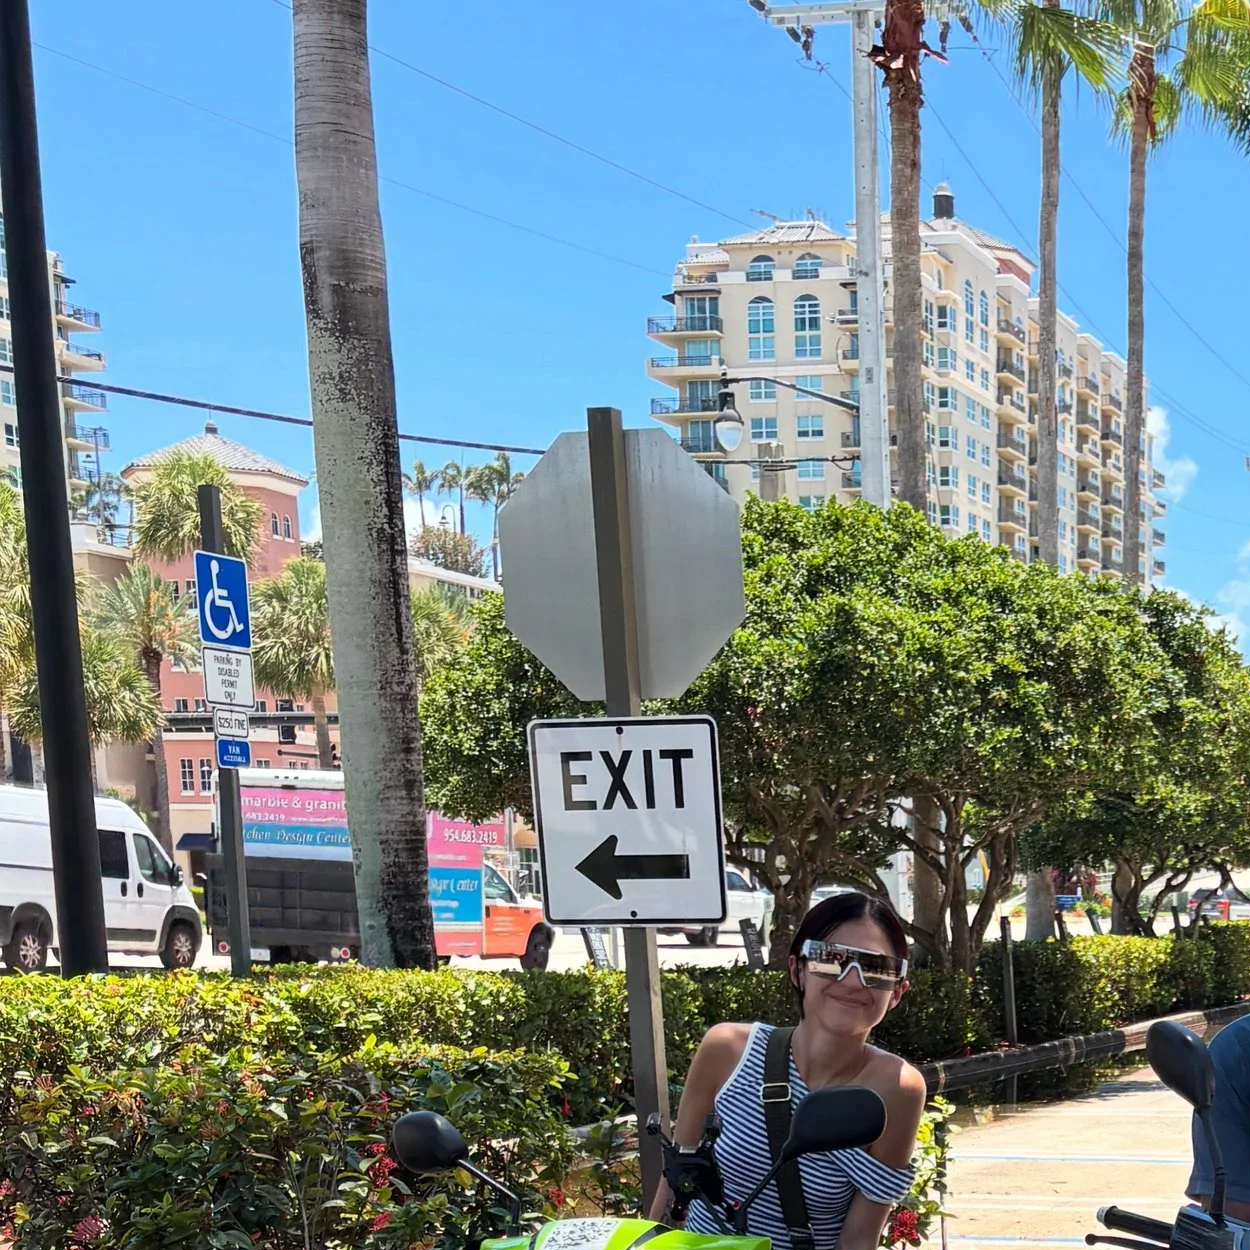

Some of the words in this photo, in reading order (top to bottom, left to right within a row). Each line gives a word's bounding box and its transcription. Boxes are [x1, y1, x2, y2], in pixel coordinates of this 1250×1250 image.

[213, 655, 233, 666] PARKING
[235, 659, 242, 667] BY
[217, 667, 240, 678] DISABLED
[221, 679, 238, 689] PERMIT
[224, 690, 236, 701] ONLY
[234, 719, 246, 731] FINE
[228, 745, 241, 754] VAN
[560, 748, 694, 811] EXIT
[240, 796, 288, 808] marble
[291, 796, 302, 808] &
[305, 799, 347, 811] granit
[444, 828, 498, 843] 954.683.2419
